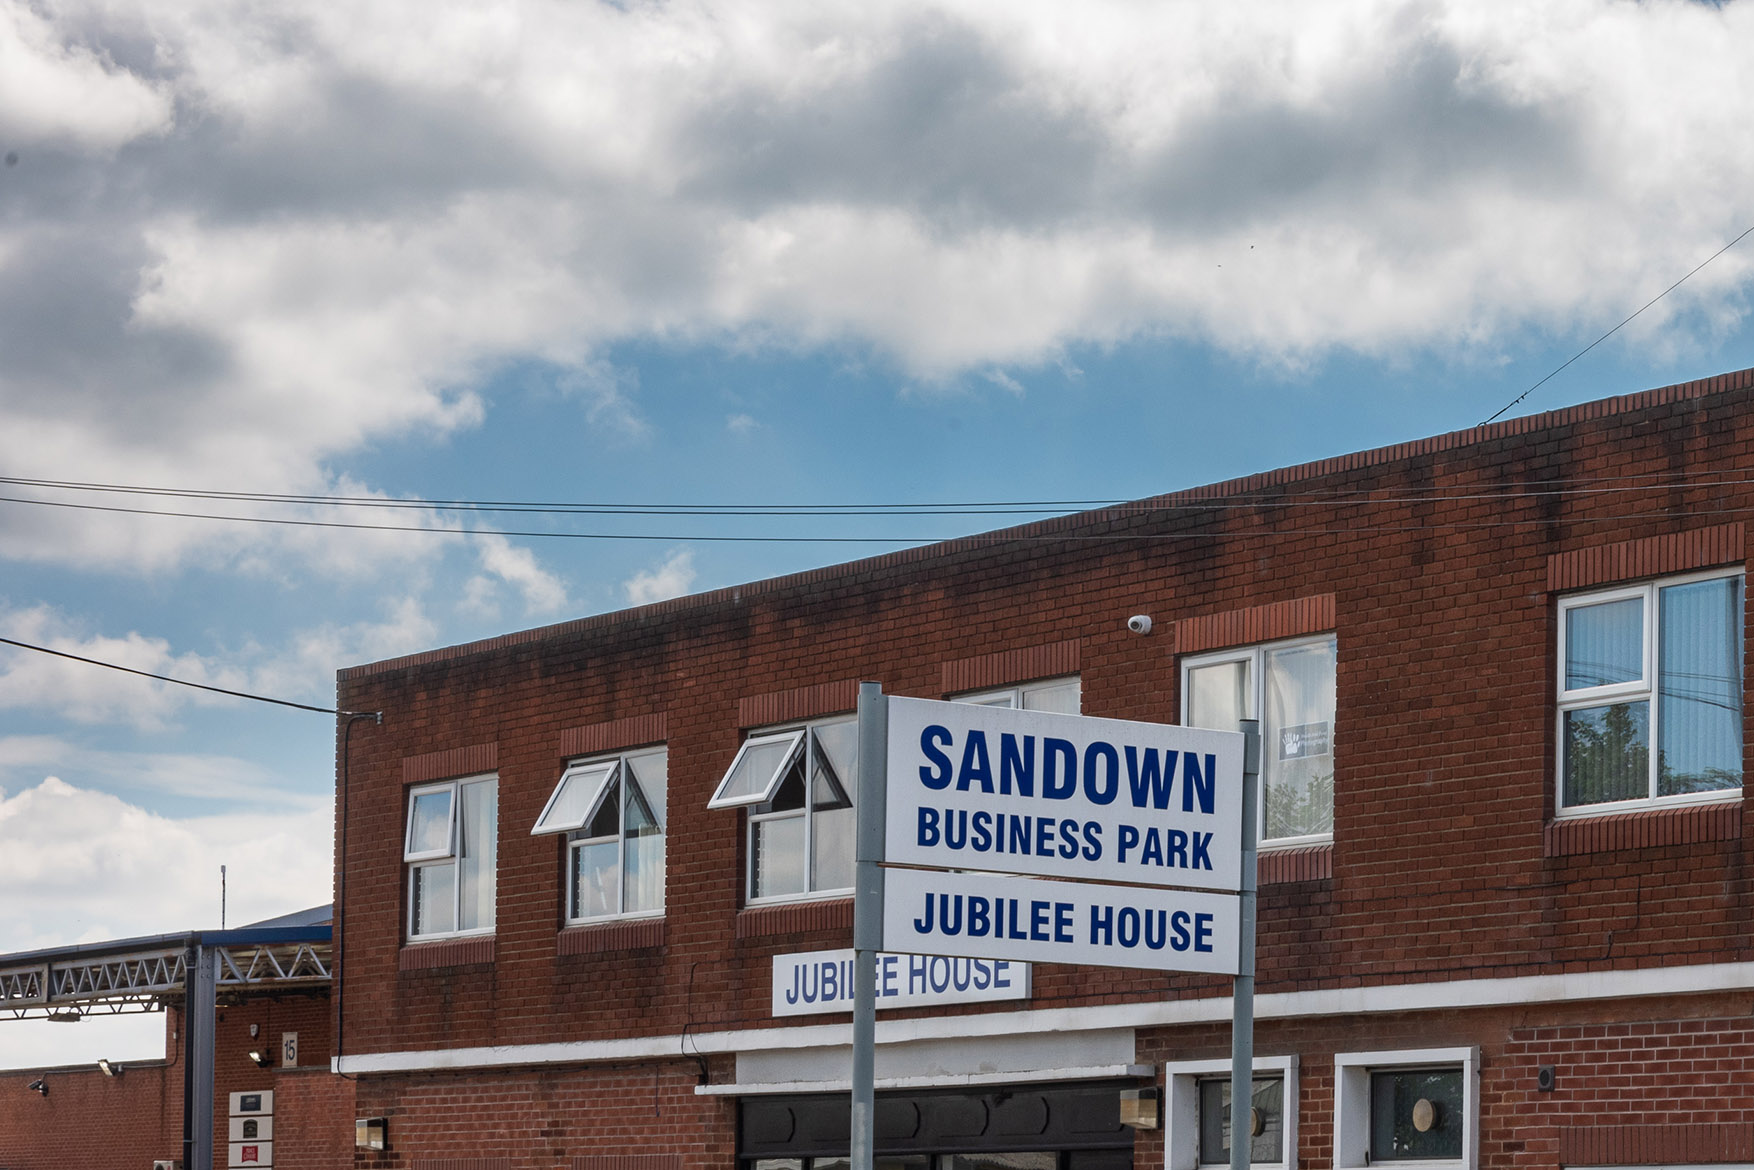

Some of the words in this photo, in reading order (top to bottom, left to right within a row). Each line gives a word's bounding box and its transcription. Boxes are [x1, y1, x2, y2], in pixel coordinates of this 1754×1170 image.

[918, 724, 1217, 814] SANDOWN
[917, 807, 1103, 861] BUSINESS
[1117, 824, 1214, 871] PARK
[914, 893, 1075, 943] JUBILEE
[1090, 905, 1214, 953] HOUSE
[908, 955, 1012, 995] HOUSE
[284, 1040, 296, 1060] 15
